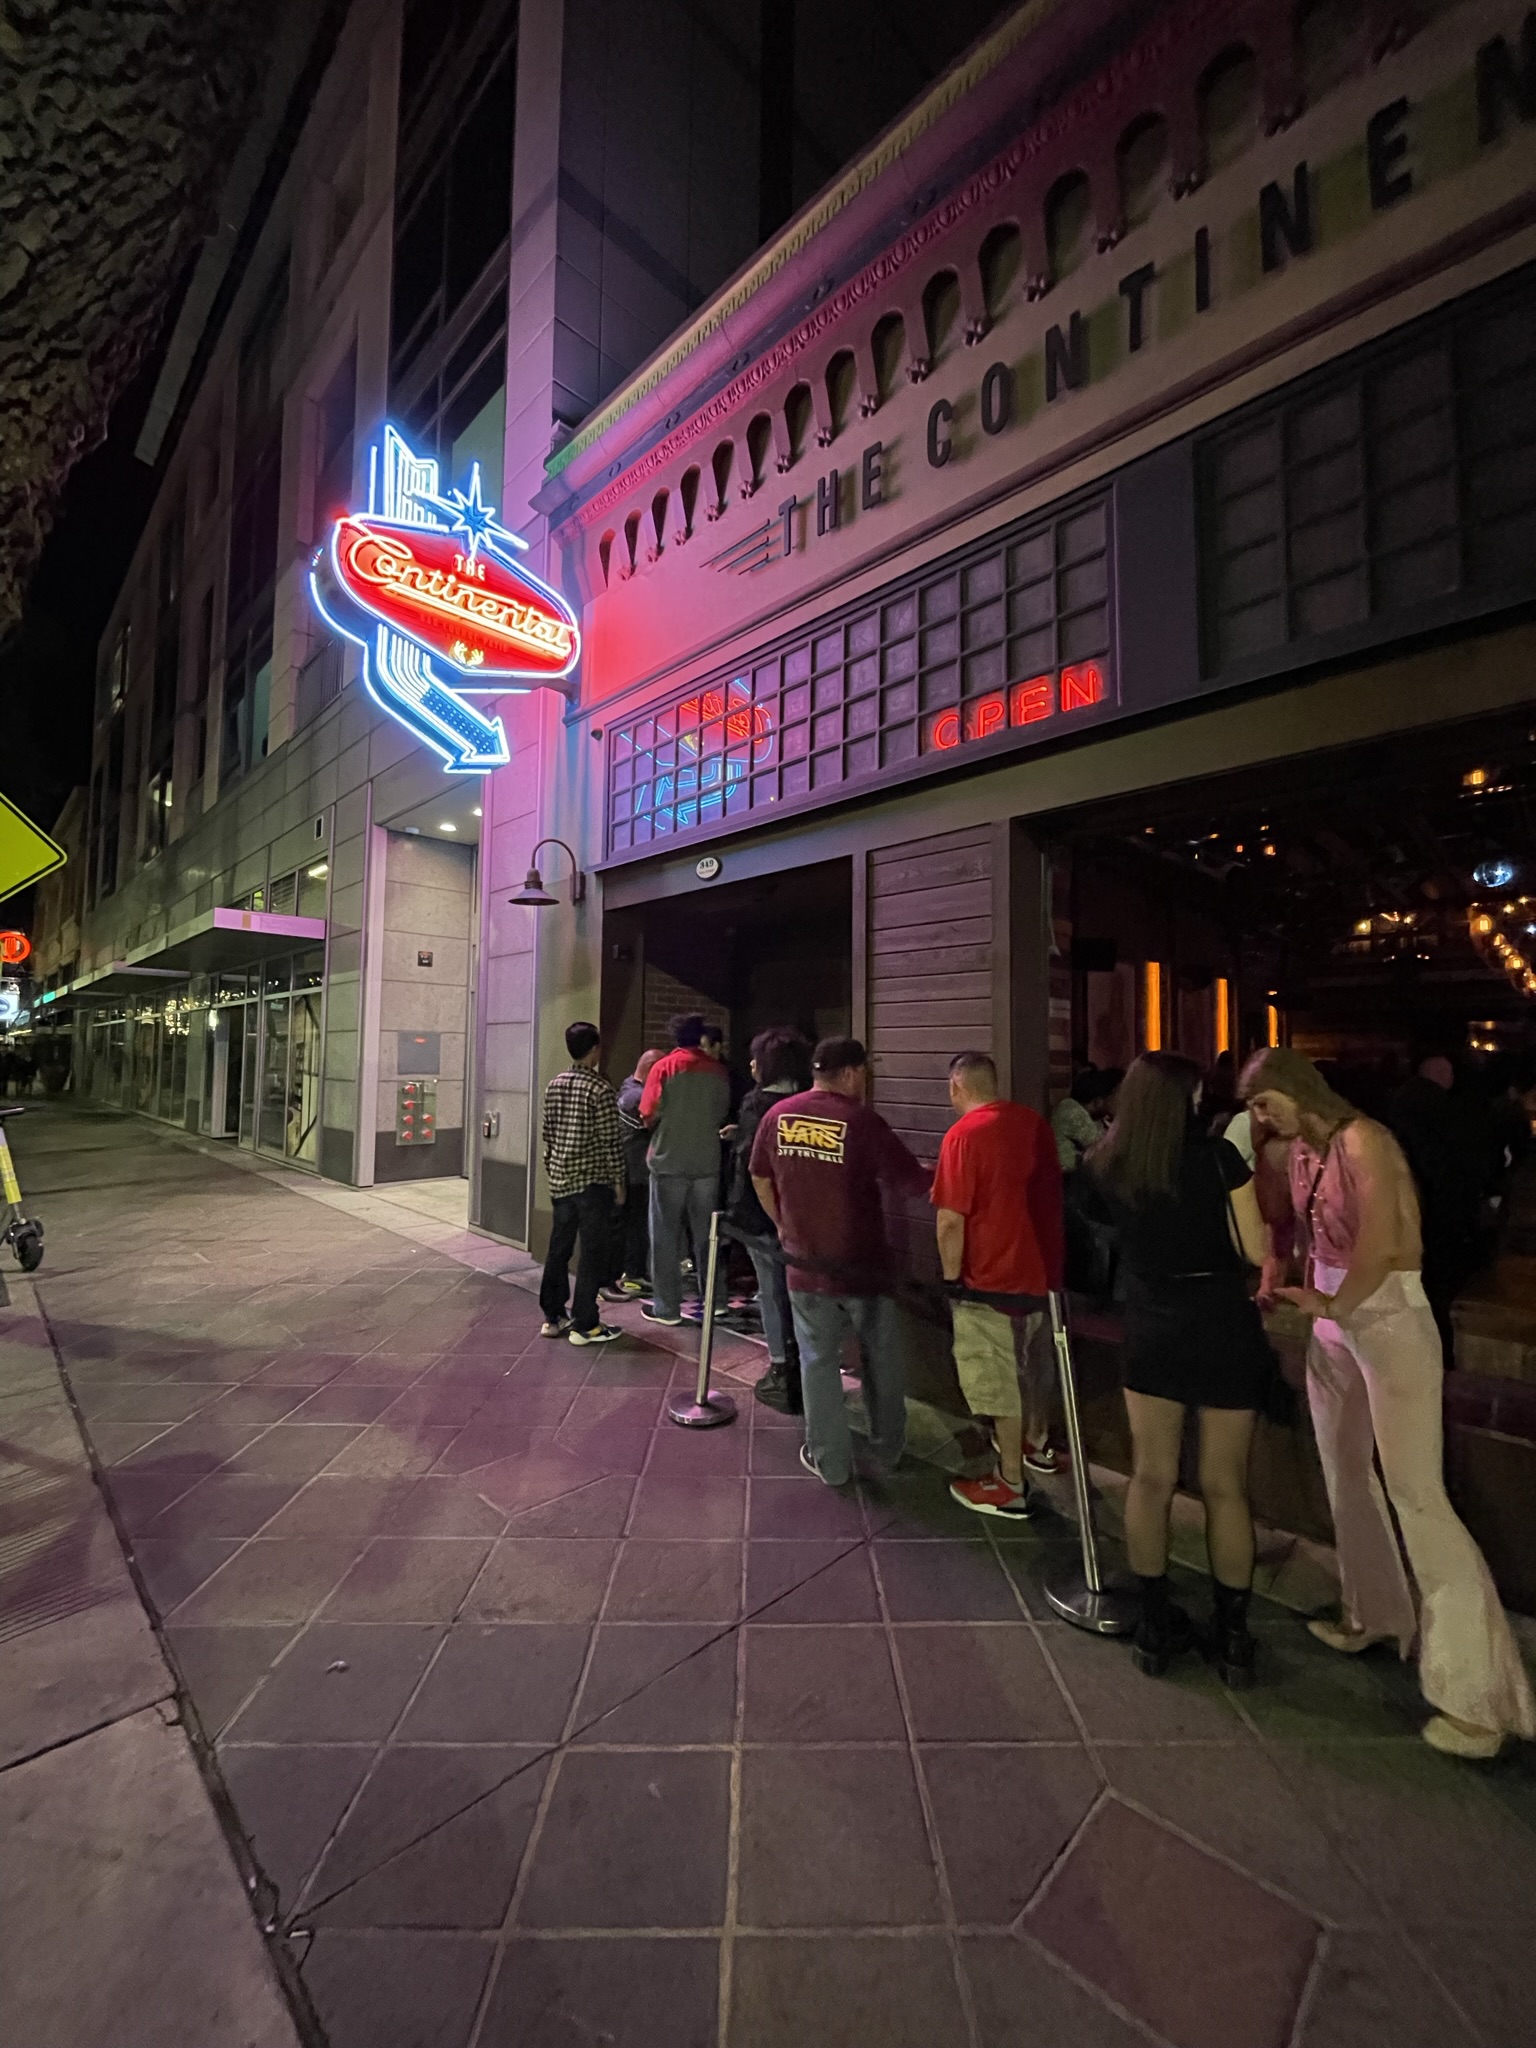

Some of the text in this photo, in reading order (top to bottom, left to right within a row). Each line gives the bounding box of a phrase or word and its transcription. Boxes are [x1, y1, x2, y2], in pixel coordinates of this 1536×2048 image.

[778, 10, 1536, 557] THE CONTINEN
[350, 534, 573, 650] Continental
[454, 553, 486, 581] THE
[934, 669, 1097, 750] OPEN
[781, 1119, 840, 1149] VANS
